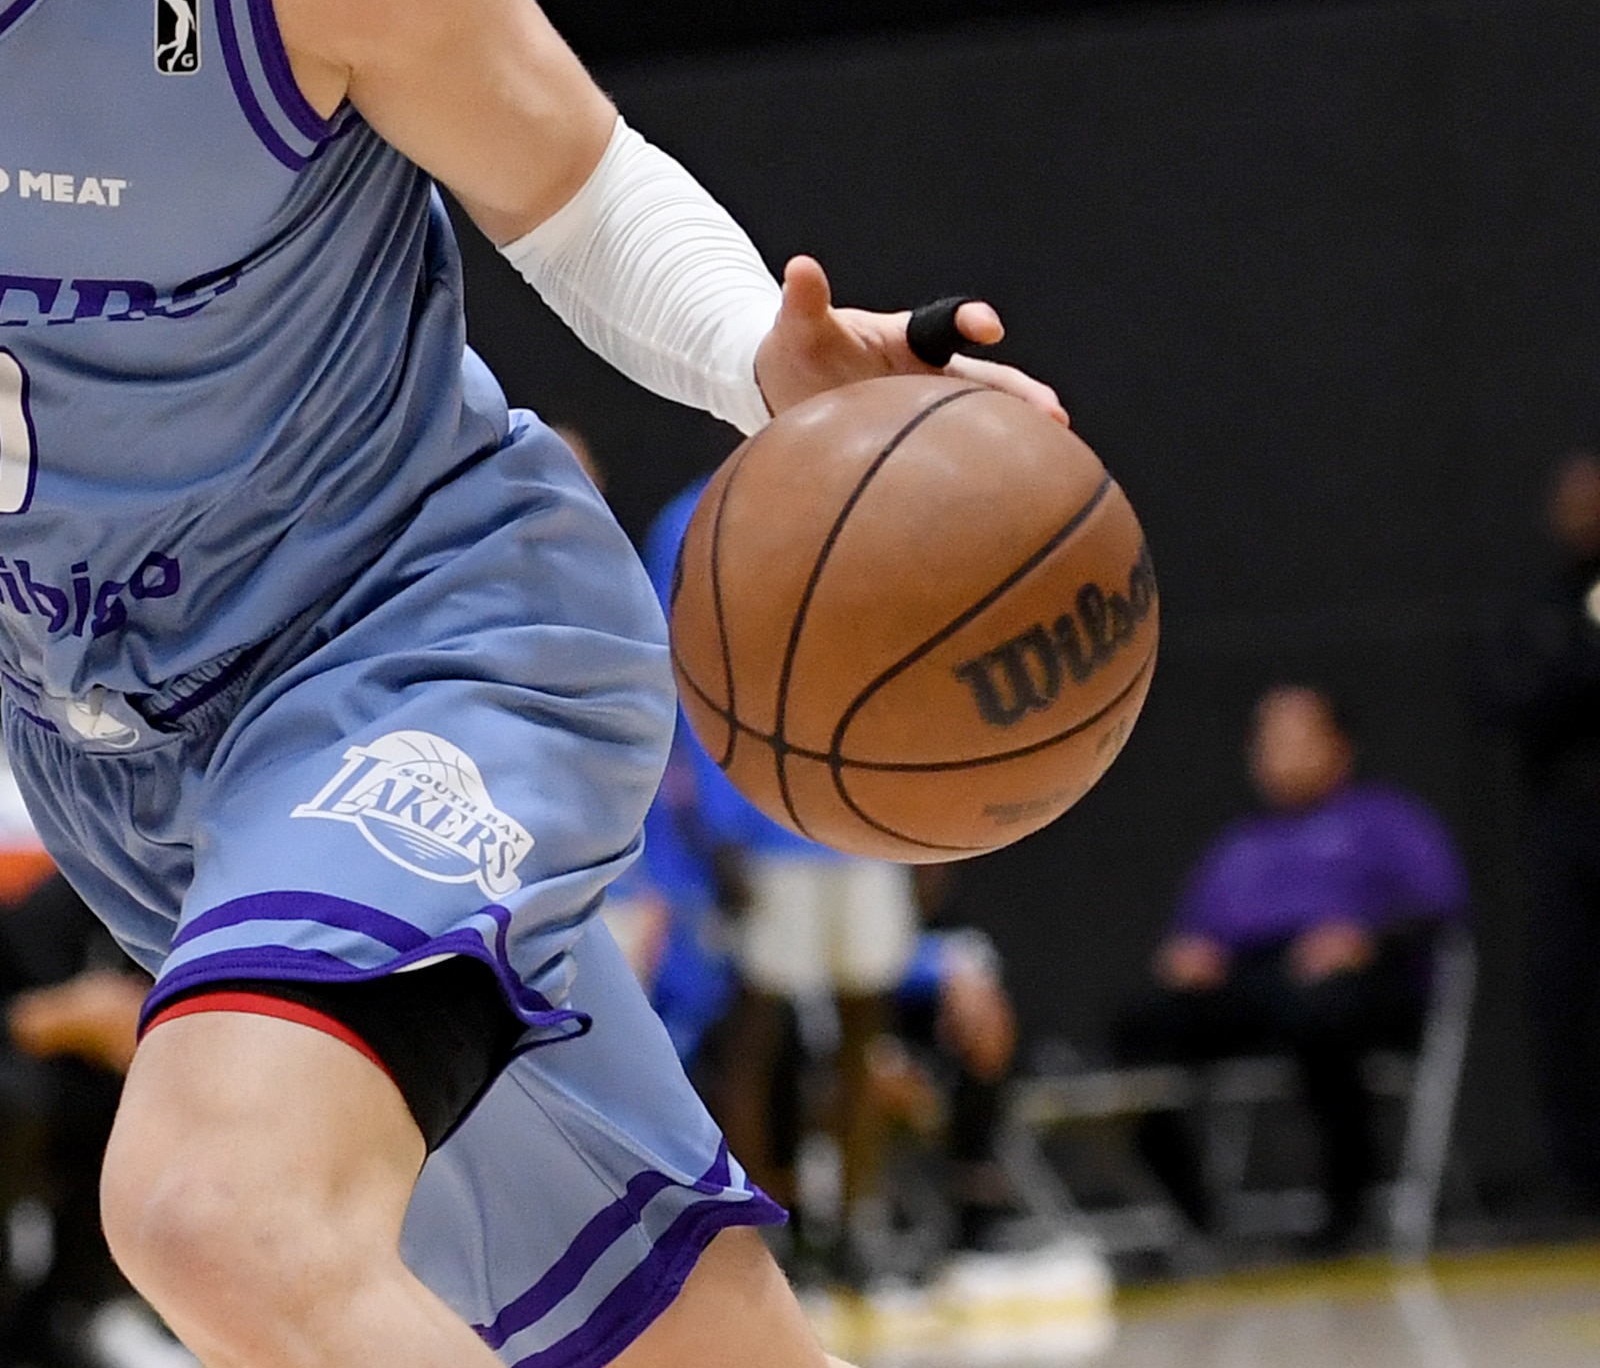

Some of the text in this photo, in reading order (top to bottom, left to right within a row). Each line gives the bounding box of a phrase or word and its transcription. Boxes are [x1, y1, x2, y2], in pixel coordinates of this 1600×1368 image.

[18, 169, 127, 207] MEAT
[955, 536, 1156, 728] Wilso
[292, 746, 520, 896] LAKERS
[398, 767, 526, 844] SOUTH BAY
